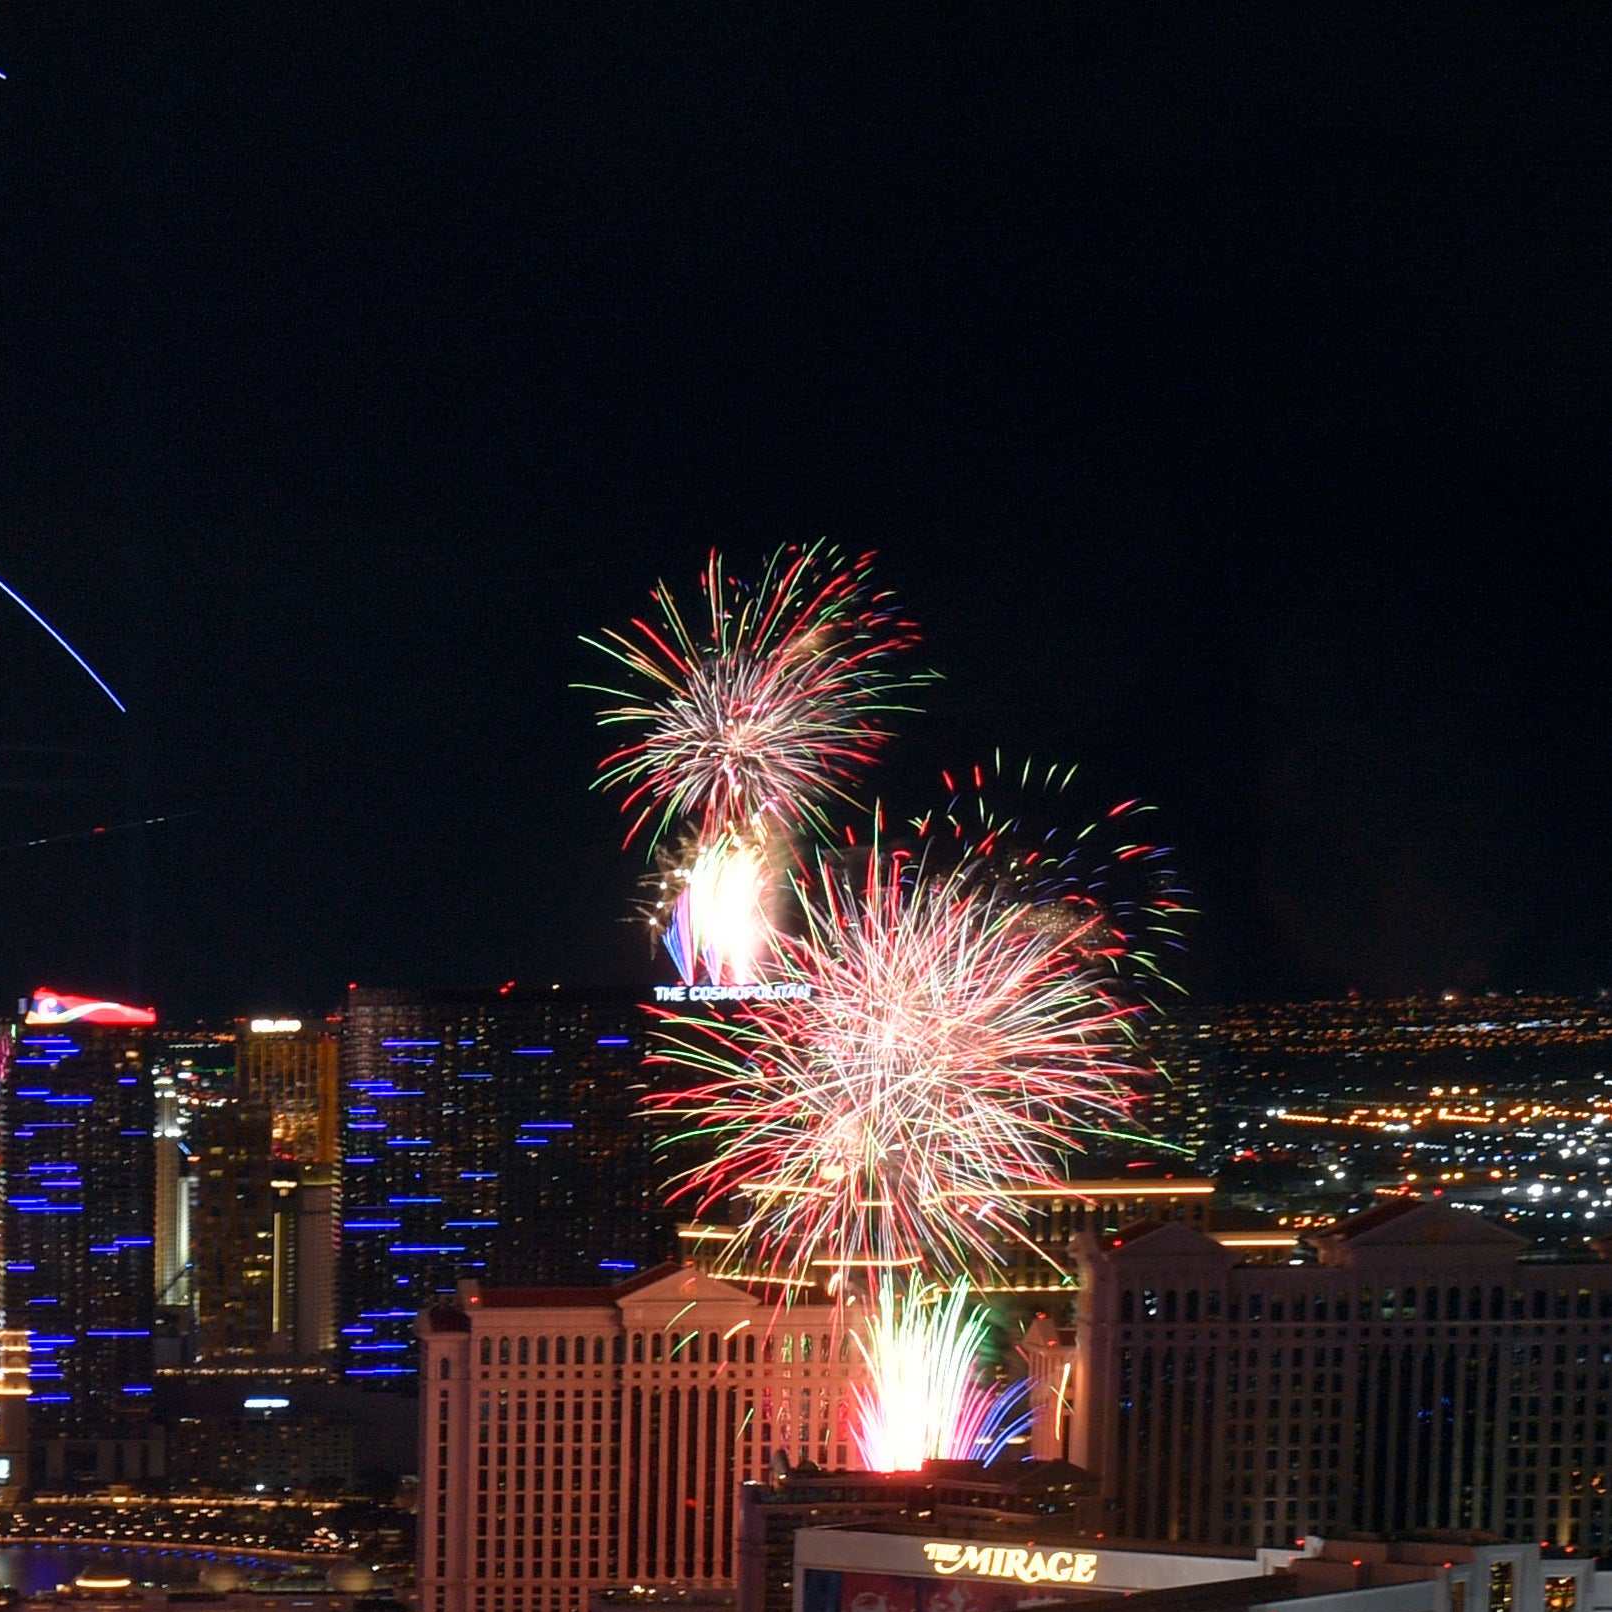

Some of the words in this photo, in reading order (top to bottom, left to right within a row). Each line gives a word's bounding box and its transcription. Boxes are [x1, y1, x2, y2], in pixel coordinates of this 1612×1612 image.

[654, 986, 687, 1001] THE
[689, 984, 811, 1001] COSMOPOLITAN
[923, 1542, 962, 1562] THE
[934, 1545, 1098, 1584] MIRAGE
